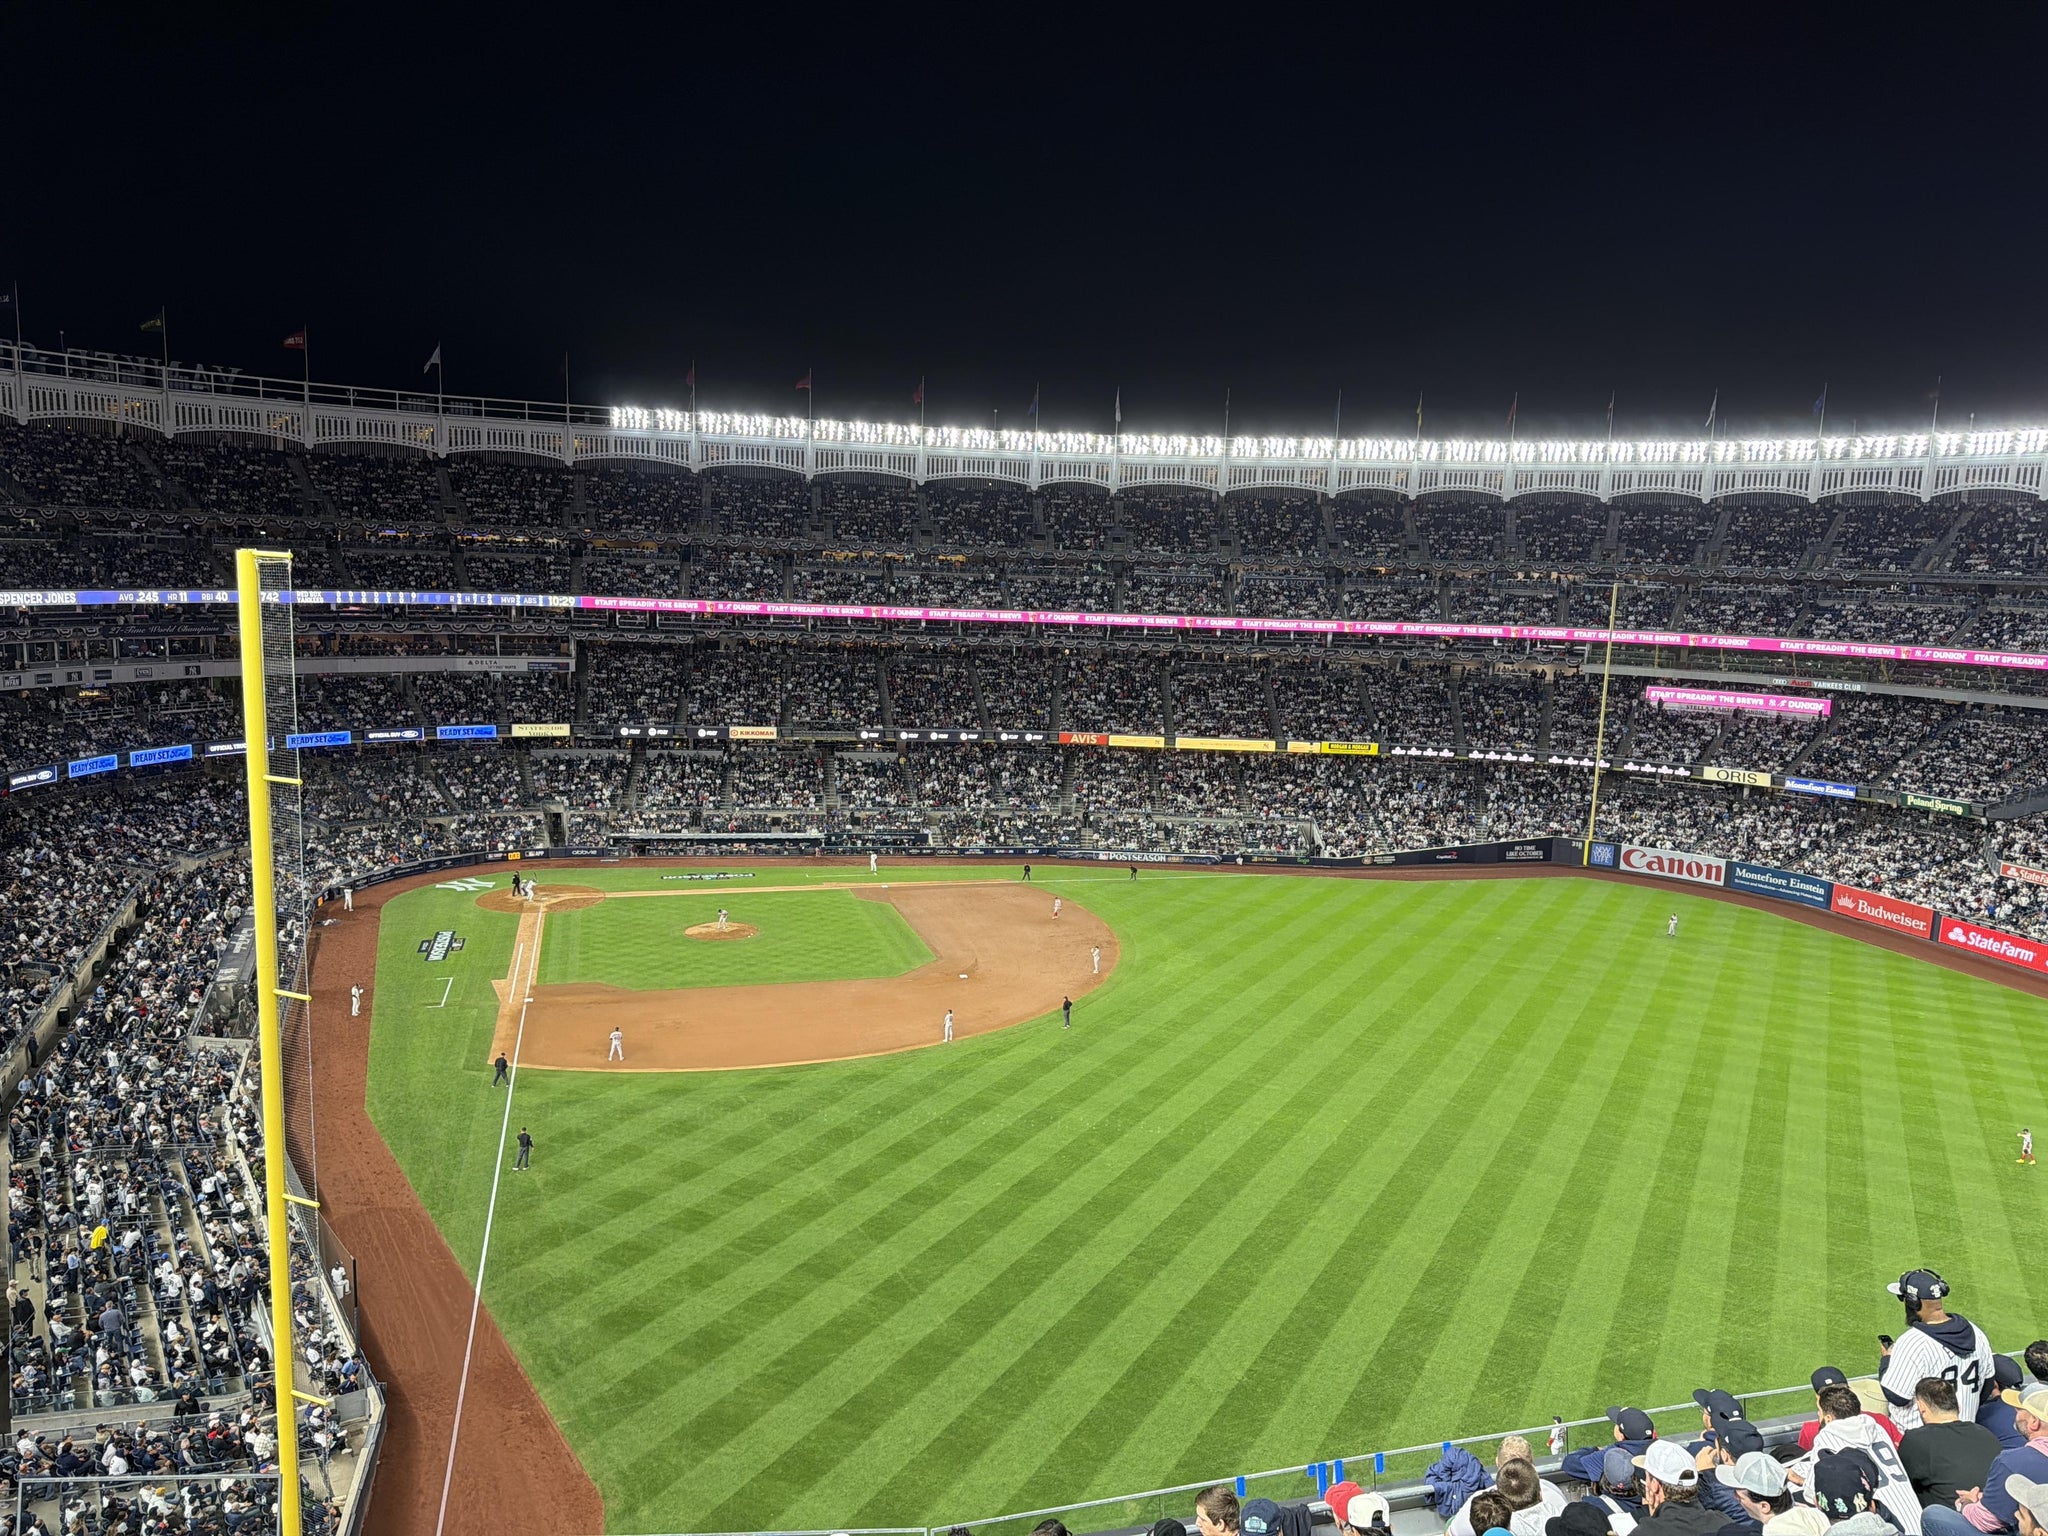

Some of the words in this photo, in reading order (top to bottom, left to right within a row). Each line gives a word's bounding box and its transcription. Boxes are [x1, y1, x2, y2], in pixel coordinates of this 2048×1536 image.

[0, 592, 43, 605] SPENCER
[45, 591, 77, 604] JONES
[119, 593, 133, 601] AVG
[136, 591, 159, 603] .245
[167, 593, 177, 601] HR
[202, 593, 214, 601] RBI
[215, 591, 229, 602] 40
[548, 595, 575, 607] 10:29
[1780, 641, 1804, 649] START
[1806, 643, 1849, 652] SPREADIN'
[1850, 644, 1866, 653] THE
[1974, 654, 1999, 663] START
[2002, 655, 2046, 666] SPREADIN'
[1790, 679, 1812, 687] Audi
[1814, 681, 1843, 689] YANKEES
[1844, 682, 1861, 691] CLUB
[1650, 690, 1675, 698] START
[1719, 695, 1735, 703] THE
[1736, 696, 1764, 706] BREWS
[291, 735, 314, 745] READY
[315, 735, 327, 743] SET
[1070, 734, 1098, 744] AVIS
[135, 752, 156, 763] READY
[158, 751, 170, 760] SET
[88, 762, 98, 770] SET
[1716, 769, 1758, 784] ORIS
[1785, 780, 1825, 793] Montefiore
[1825, 785, 1855, 797] Einstein
[1907, 795, 1934, 808] Poland
[1934, 799, 1963, 815] Spring
[1109, 853, 1167, 862] POSTSEASON
[1621, 848, 1722, 883] Canon
[1735, 867, 1788, 886] Montefiore
[1789, 878, 1825, 895] Einstein
